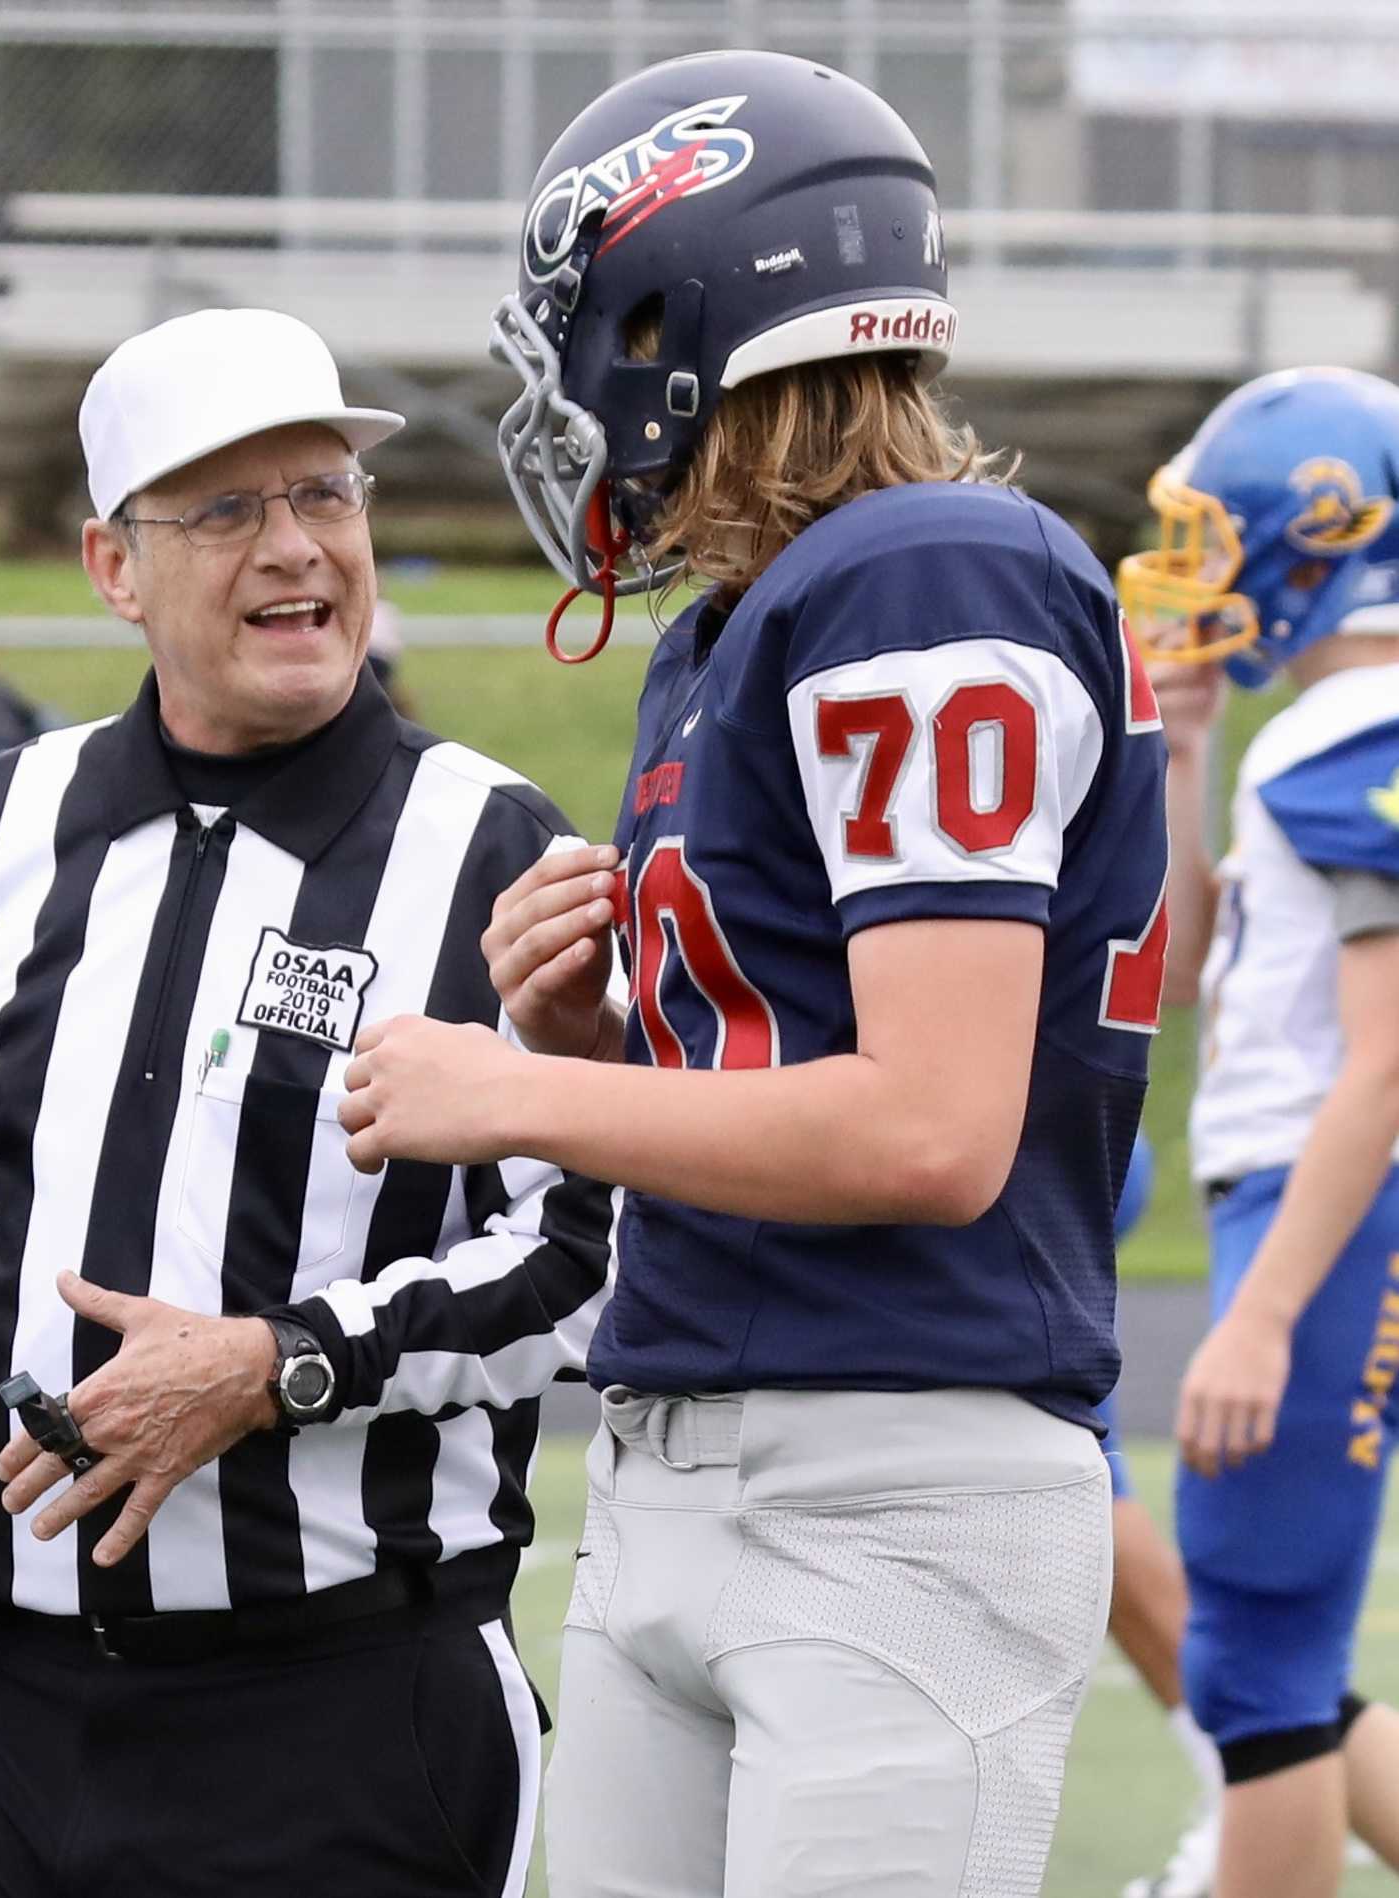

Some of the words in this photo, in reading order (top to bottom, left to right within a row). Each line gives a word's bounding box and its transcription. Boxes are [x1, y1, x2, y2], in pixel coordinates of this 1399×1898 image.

[850, 308, 956, 345] Riddell
[814, 676, 1042, 863] 70
[266, 970, 345, 1003] FOOTBALL
[272, 950, 354, 990] OSAA
[279, 988, 331, 1018] 2019
[253, 1003, 340, 1043] OFFICIAL
